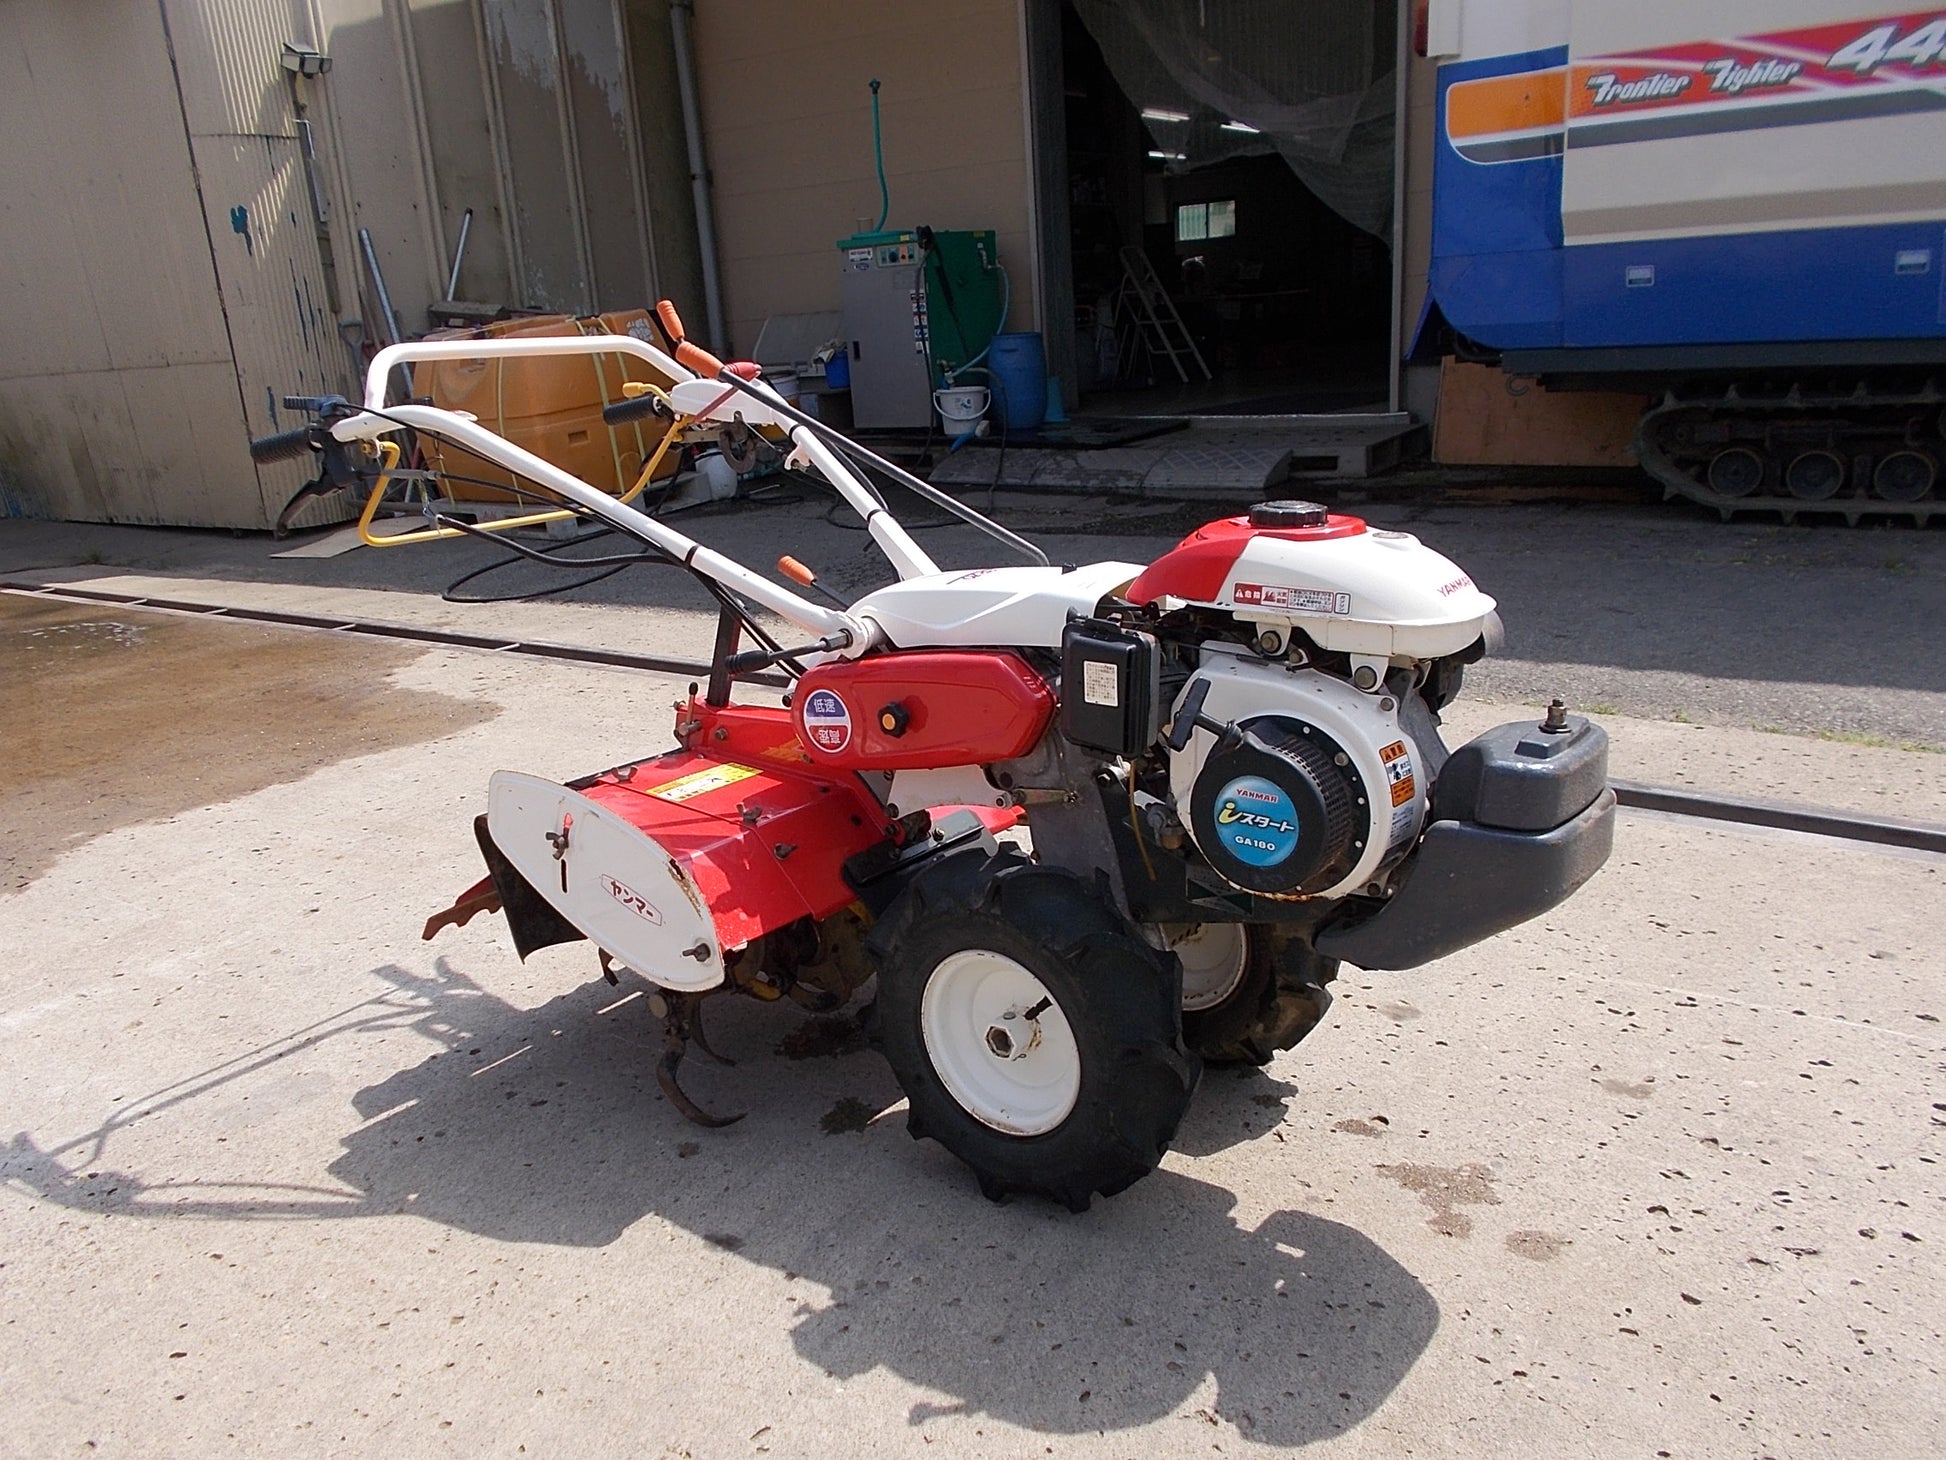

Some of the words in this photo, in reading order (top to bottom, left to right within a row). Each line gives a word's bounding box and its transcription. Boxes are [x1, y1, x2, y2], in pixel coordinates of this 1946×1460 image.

[1586, 73, 1691, 105] Frontier
[1703, 58, 1801, 95] Fighter
[1825, 19, 1946, 74] 44
[814, 698, 836, 713] 低速
[818, 729, 841, 744] 高速
[1235, 788, 1279, 803] YANMAR
[1235, 835, 1276, 852] GA180
[610, 880, 654, 917] ヤンマー
